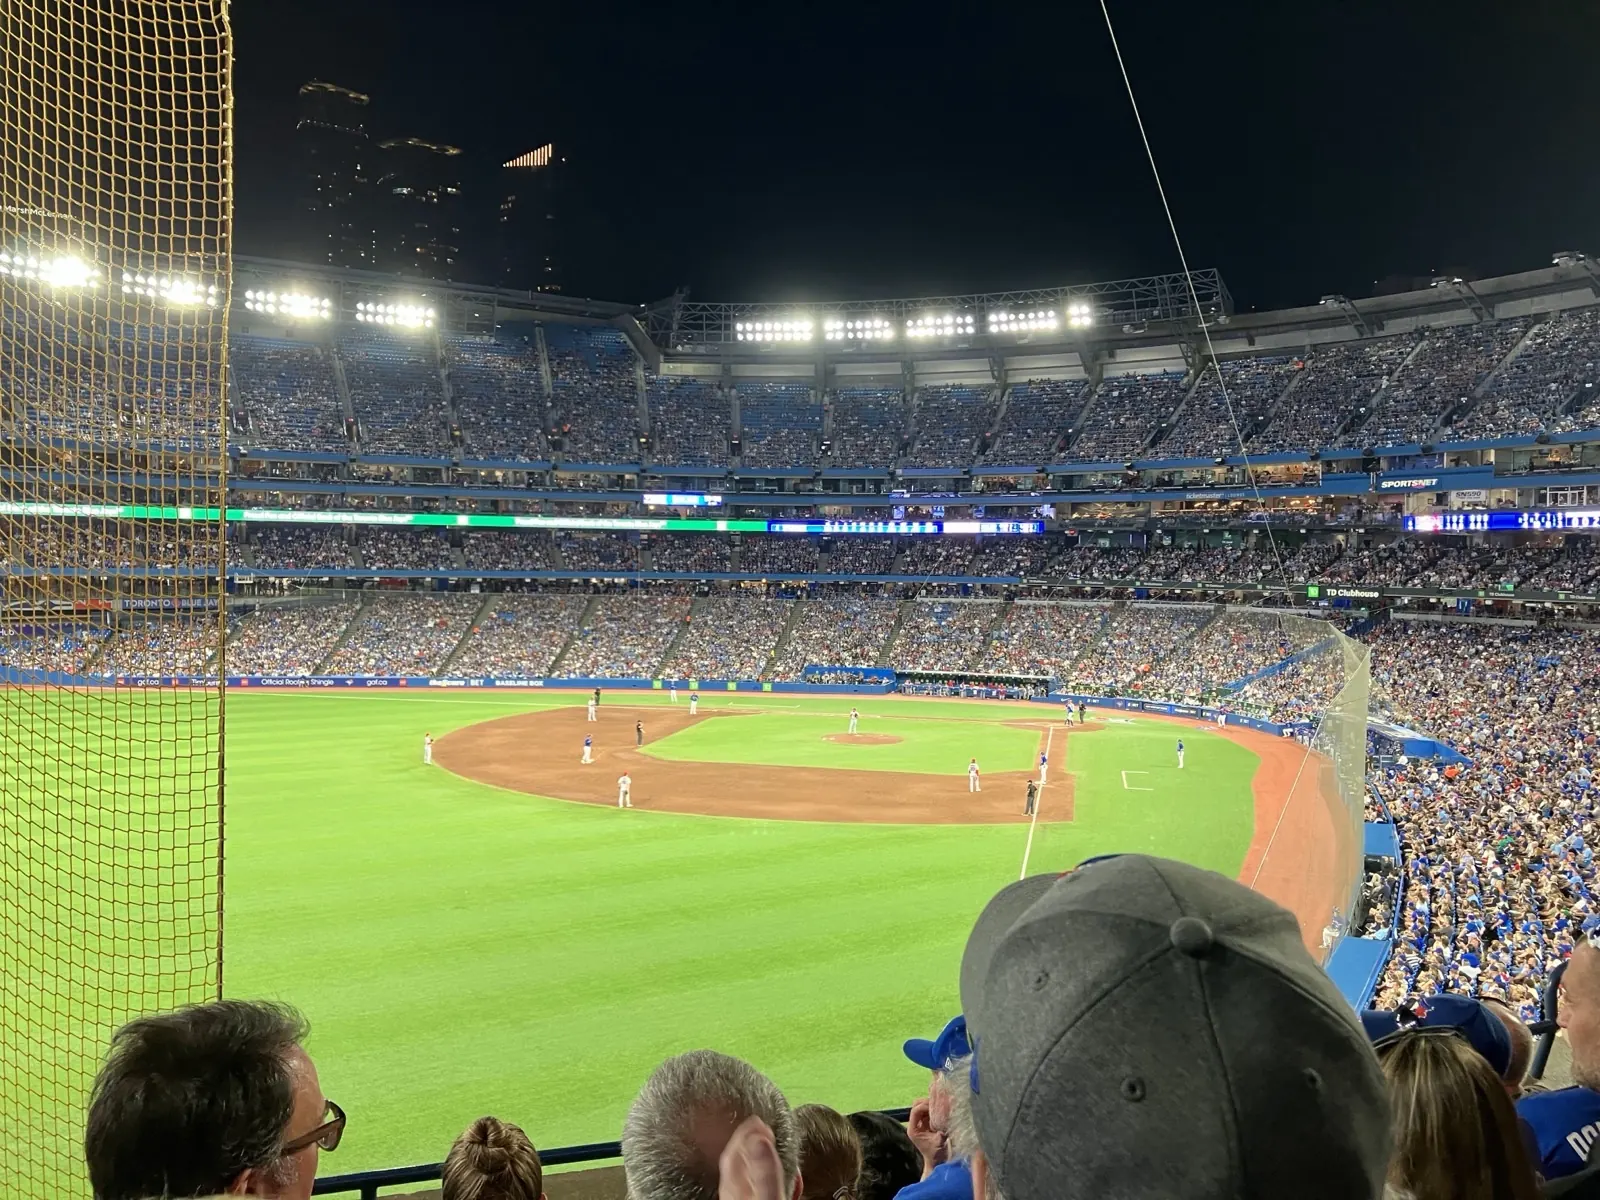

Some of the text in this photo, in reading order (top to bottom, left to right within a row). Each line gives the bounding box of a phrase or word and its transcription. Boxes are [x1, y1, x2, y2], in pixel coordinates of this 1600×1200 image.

[1381, 479, 1438, 489] SPORTSNET
[1326, 588, 1379, 598] TD Clubhouse
[124, 599, 219, 608] TORONTO BLUE JAY
[285, 679, 310, 687] Roof
[310, 679, 335, 687] Shingle
[367, 679, 388, 687] gaf.ca
[1566, 1121, 1600, 1162] DO
